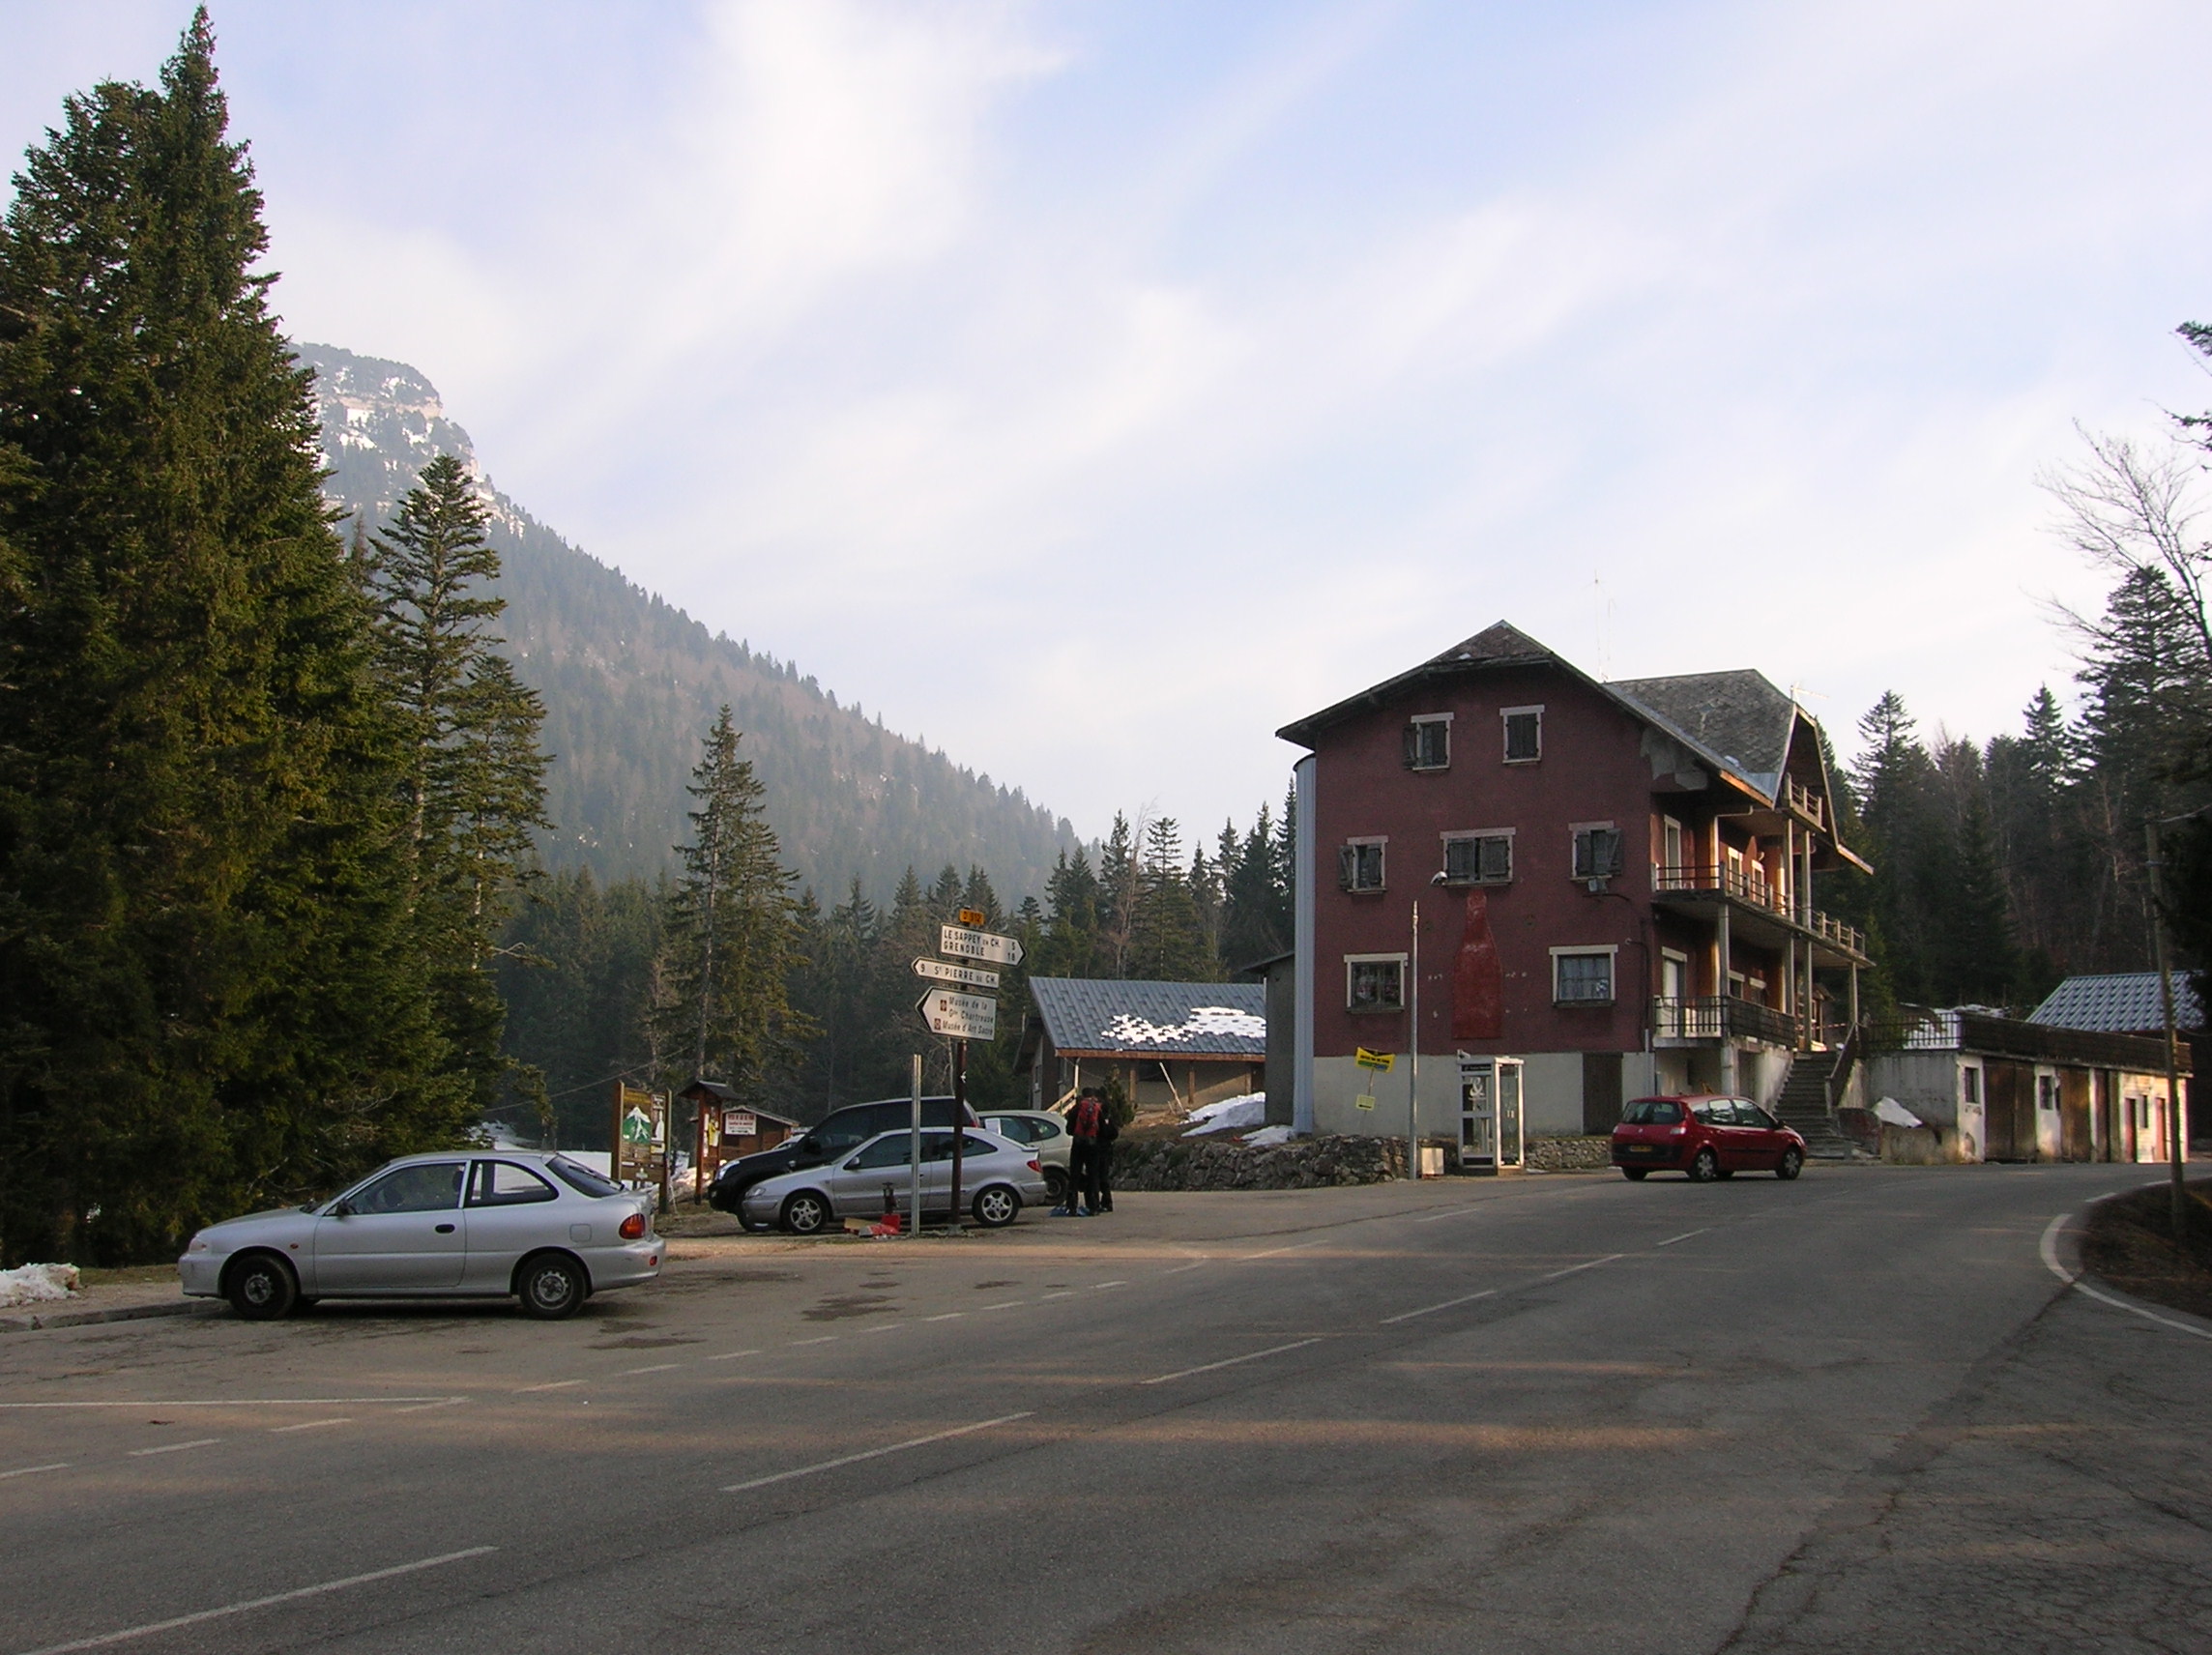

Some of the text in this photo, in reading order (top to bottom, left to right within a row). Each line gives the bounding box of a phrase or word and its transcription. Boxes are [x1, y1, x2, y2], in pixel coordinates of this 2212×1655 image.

[944, 929, 952, 940] LE
[954, 931, 981, 944] SAPPEY
[944, 941, 984, 956] GRENOBLE
[920, 963, 925, 973] 9
[945, 967, 974, 981] PIERRE
[949, 996, 969, 1007] Musée
[961, 1010, 994, 1023] Chartreuse
[943, 1020, 960, 1031] Musée
